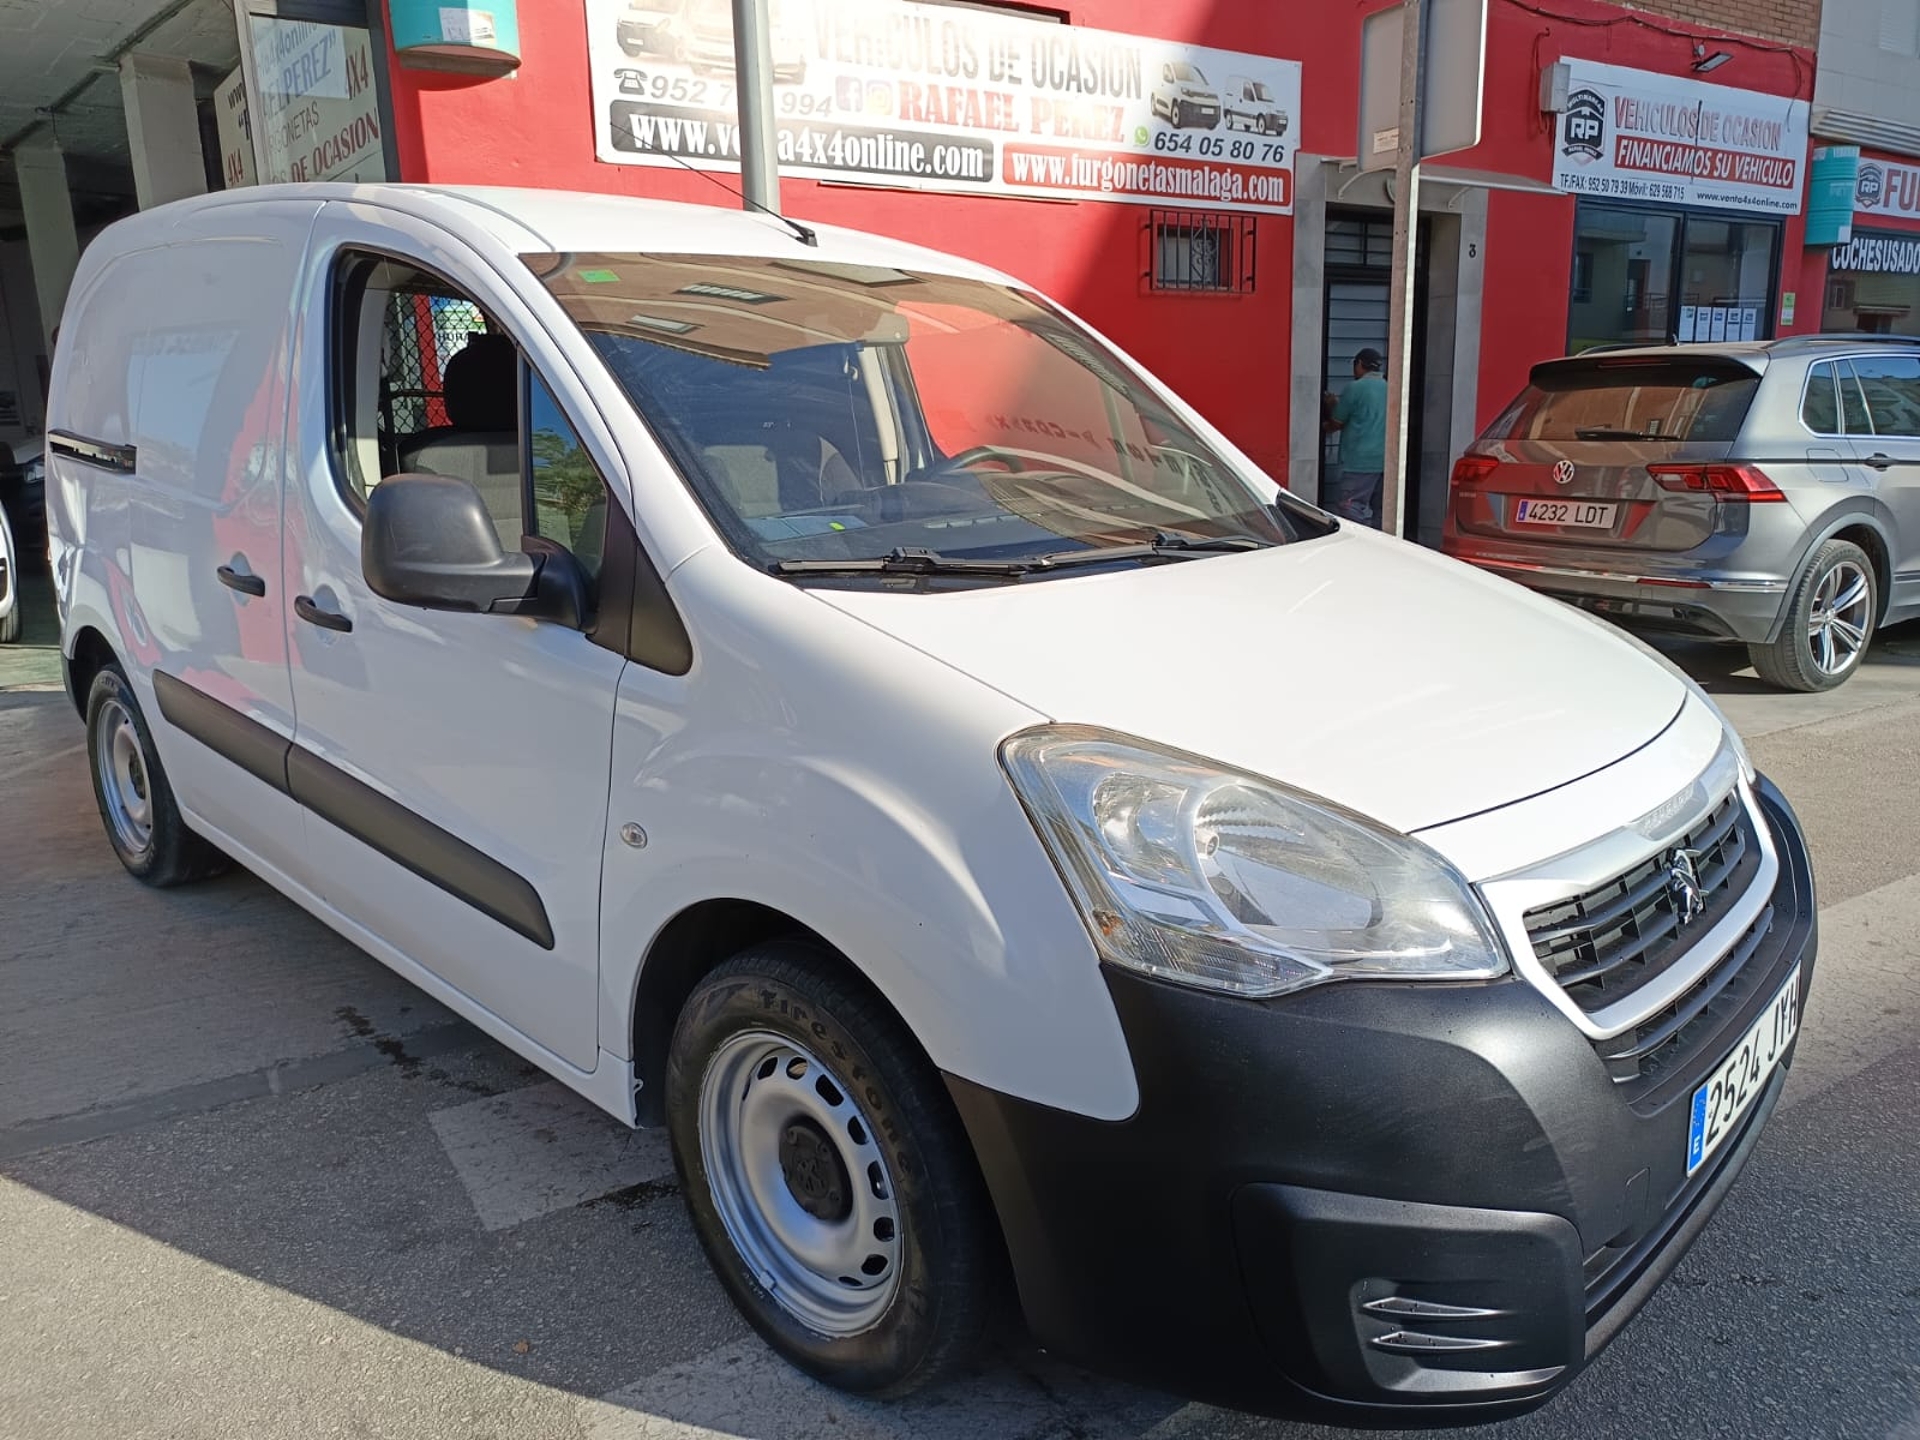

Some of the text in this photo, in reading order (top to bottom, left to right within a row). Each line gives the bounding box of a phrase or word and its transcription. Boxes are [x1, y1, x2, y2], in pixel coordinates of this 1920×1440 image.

[988, 32, 1022, 85] DE
[1030, 36, 1142, 99] OCASION
[650, 75, 708, 104] 952
[780, 91, 833, 118] 994
[897, 80, 1020, 133] RAFAEL
[312, 106, 379, 176] OCASION
[1153, 130, 1286, 163] 654 05 80 76
[1570, 117, 1600, 140] RP
[1613, 95, 1782, 151] VEHICULOS DE OCASION
[1011, 153, 1284, 202] www.furgonetasmalaga.com
[1617, 139, 1794, 186] FINANCIAMOS SU VEHICULO
[1529, 502, 1609, 524] 4232 LDT
[1704, 1029, 1761, 1148] 2524
